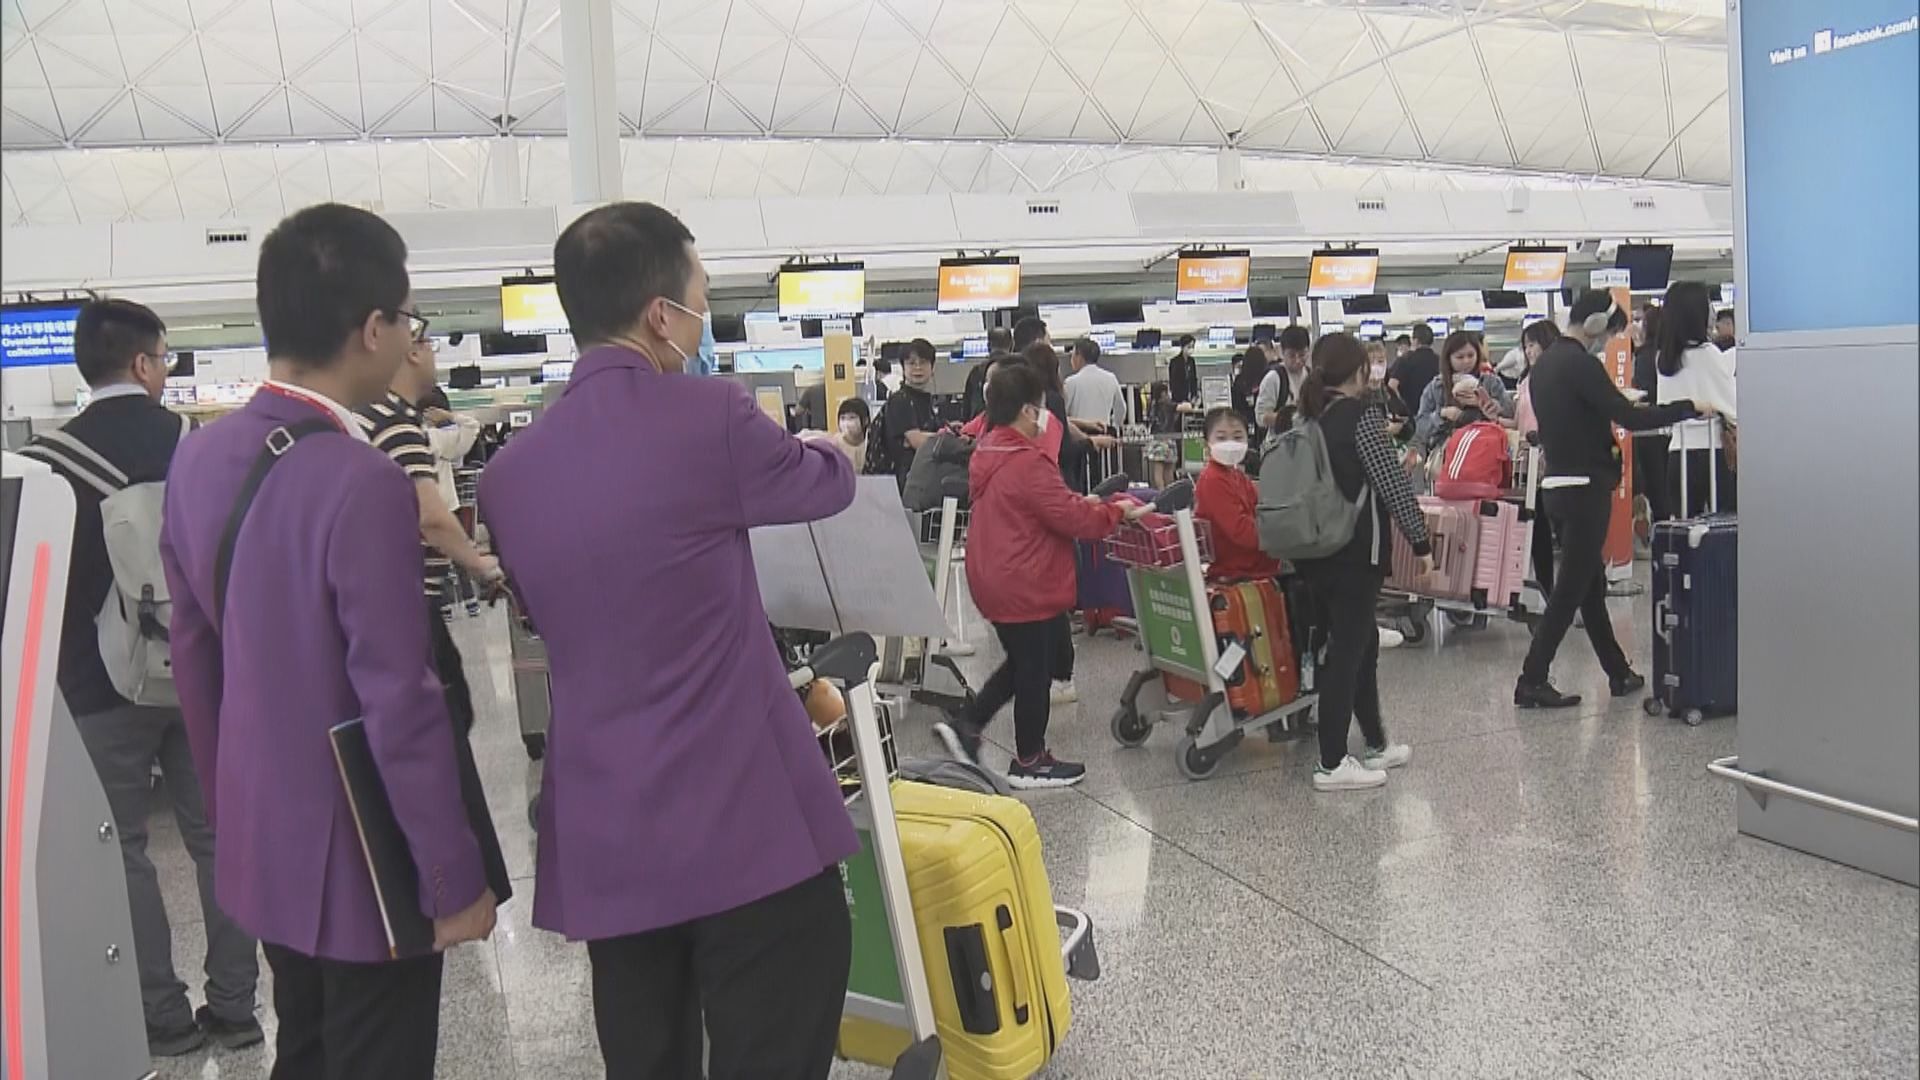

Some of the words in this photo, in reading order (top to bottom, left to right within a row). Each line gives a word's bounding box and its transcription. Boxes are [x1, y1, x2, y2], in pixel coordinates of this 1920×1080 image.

[1769, 49, 1793, 64] Visit
[1794, 46, 1807, 59] us
[6, 346, 52, 357] collection
